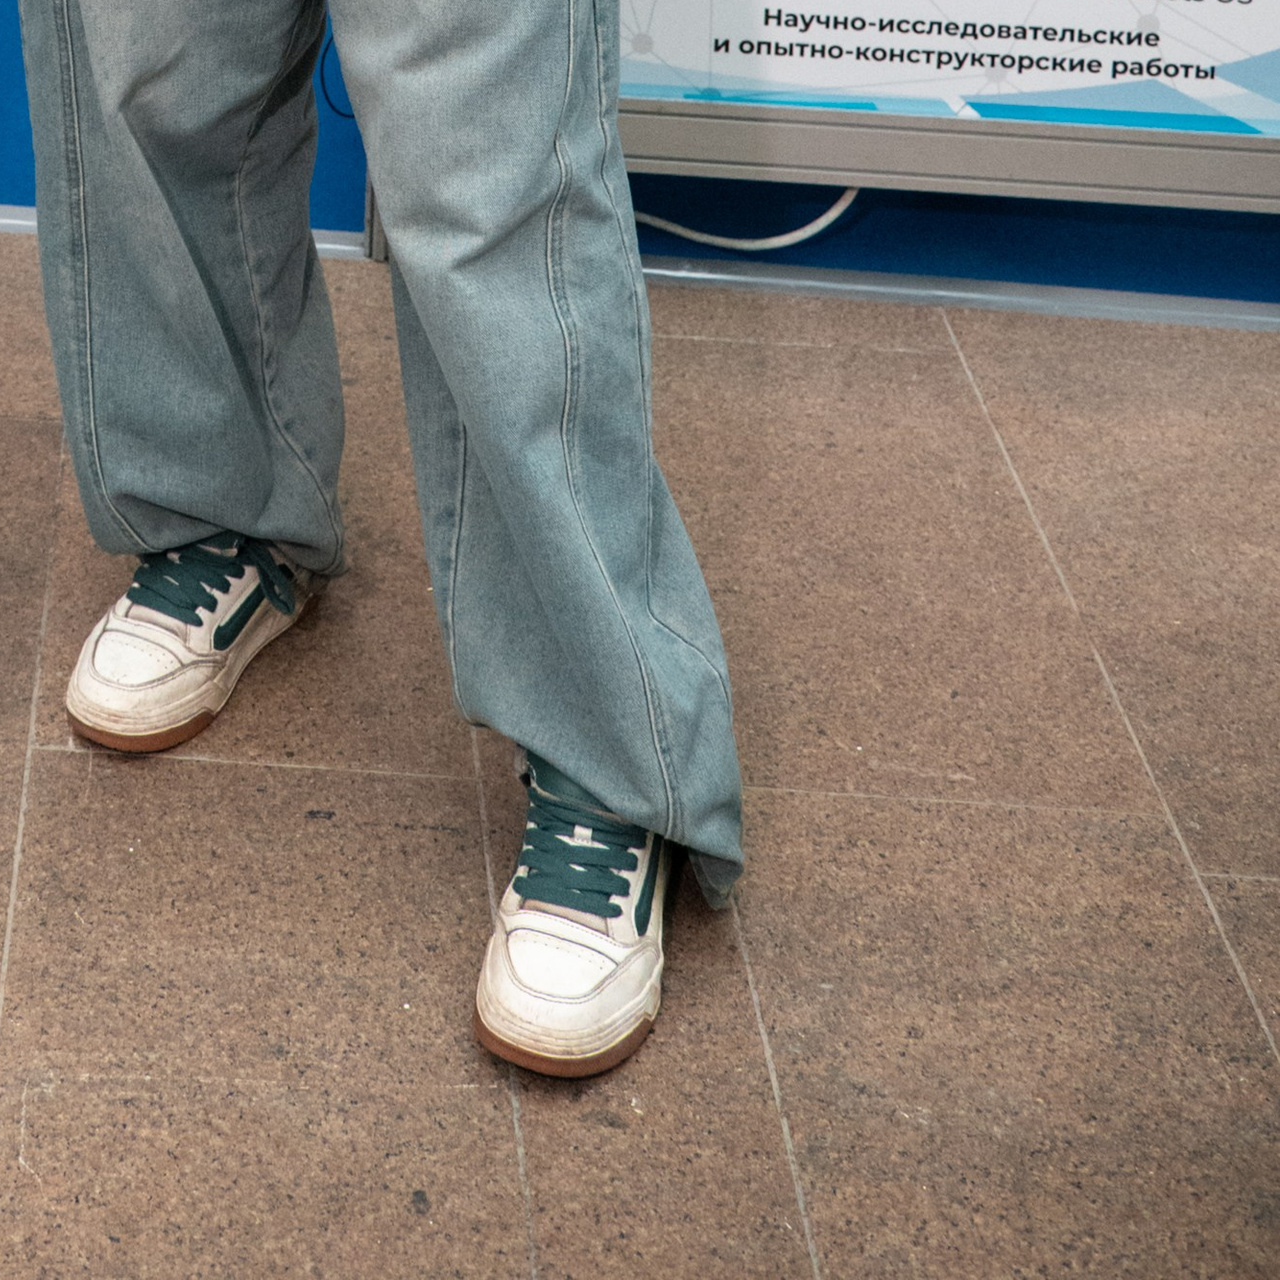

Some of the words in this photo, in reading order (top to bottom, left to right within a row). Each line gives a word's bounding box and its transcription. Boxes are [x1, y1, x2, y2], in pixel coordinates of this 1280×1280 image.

[763, 8, 1160, 47] Научно-исследовательские
[714, 39, 729, 53] и
[739, 39, 1102, 75] опытно-конструкторские
[1112, 58, 1215, 79] работы
